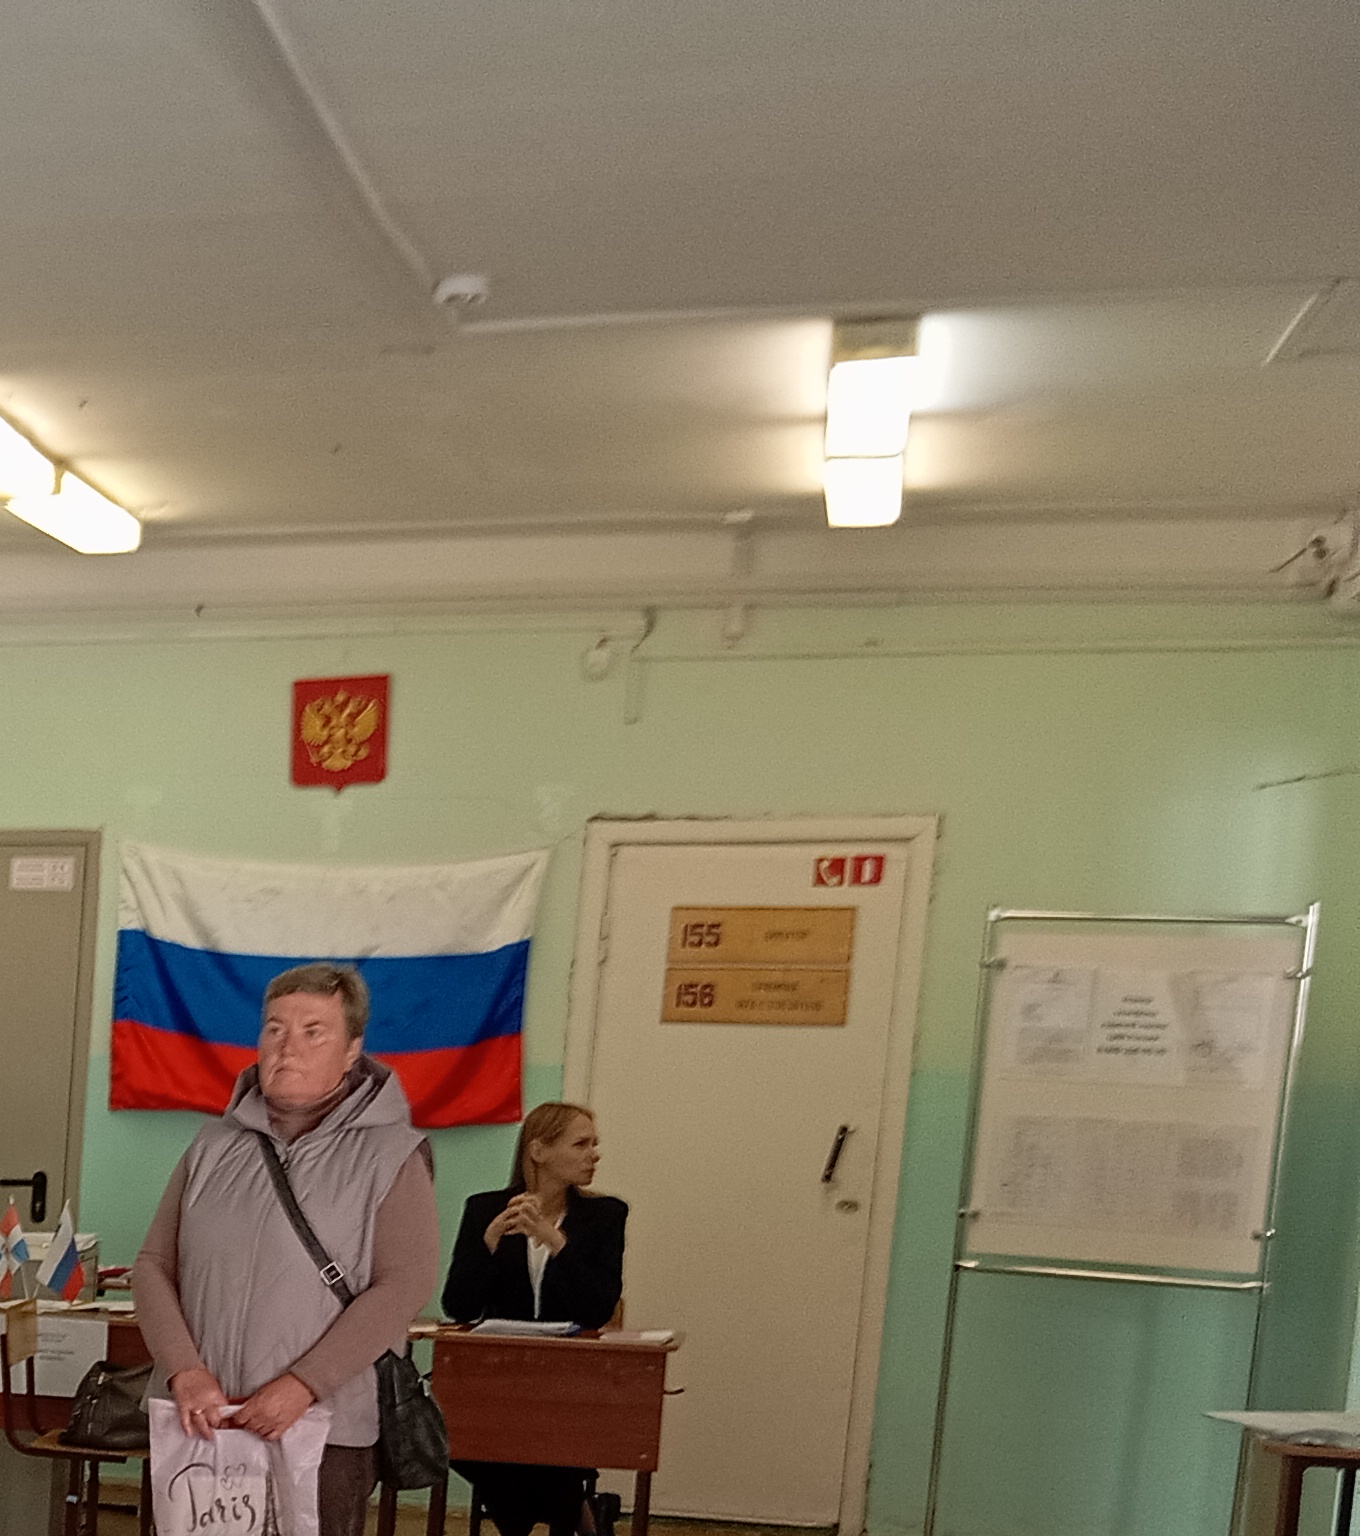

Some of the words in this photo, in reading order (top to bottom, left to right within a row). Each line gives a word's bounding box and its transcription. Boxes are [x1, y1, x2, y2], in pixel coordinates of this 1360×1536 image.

[681, 922, 722, 949] 155
[675, 982, 715, 1009] 156
[168, 1462, 256, 1532] Paris
